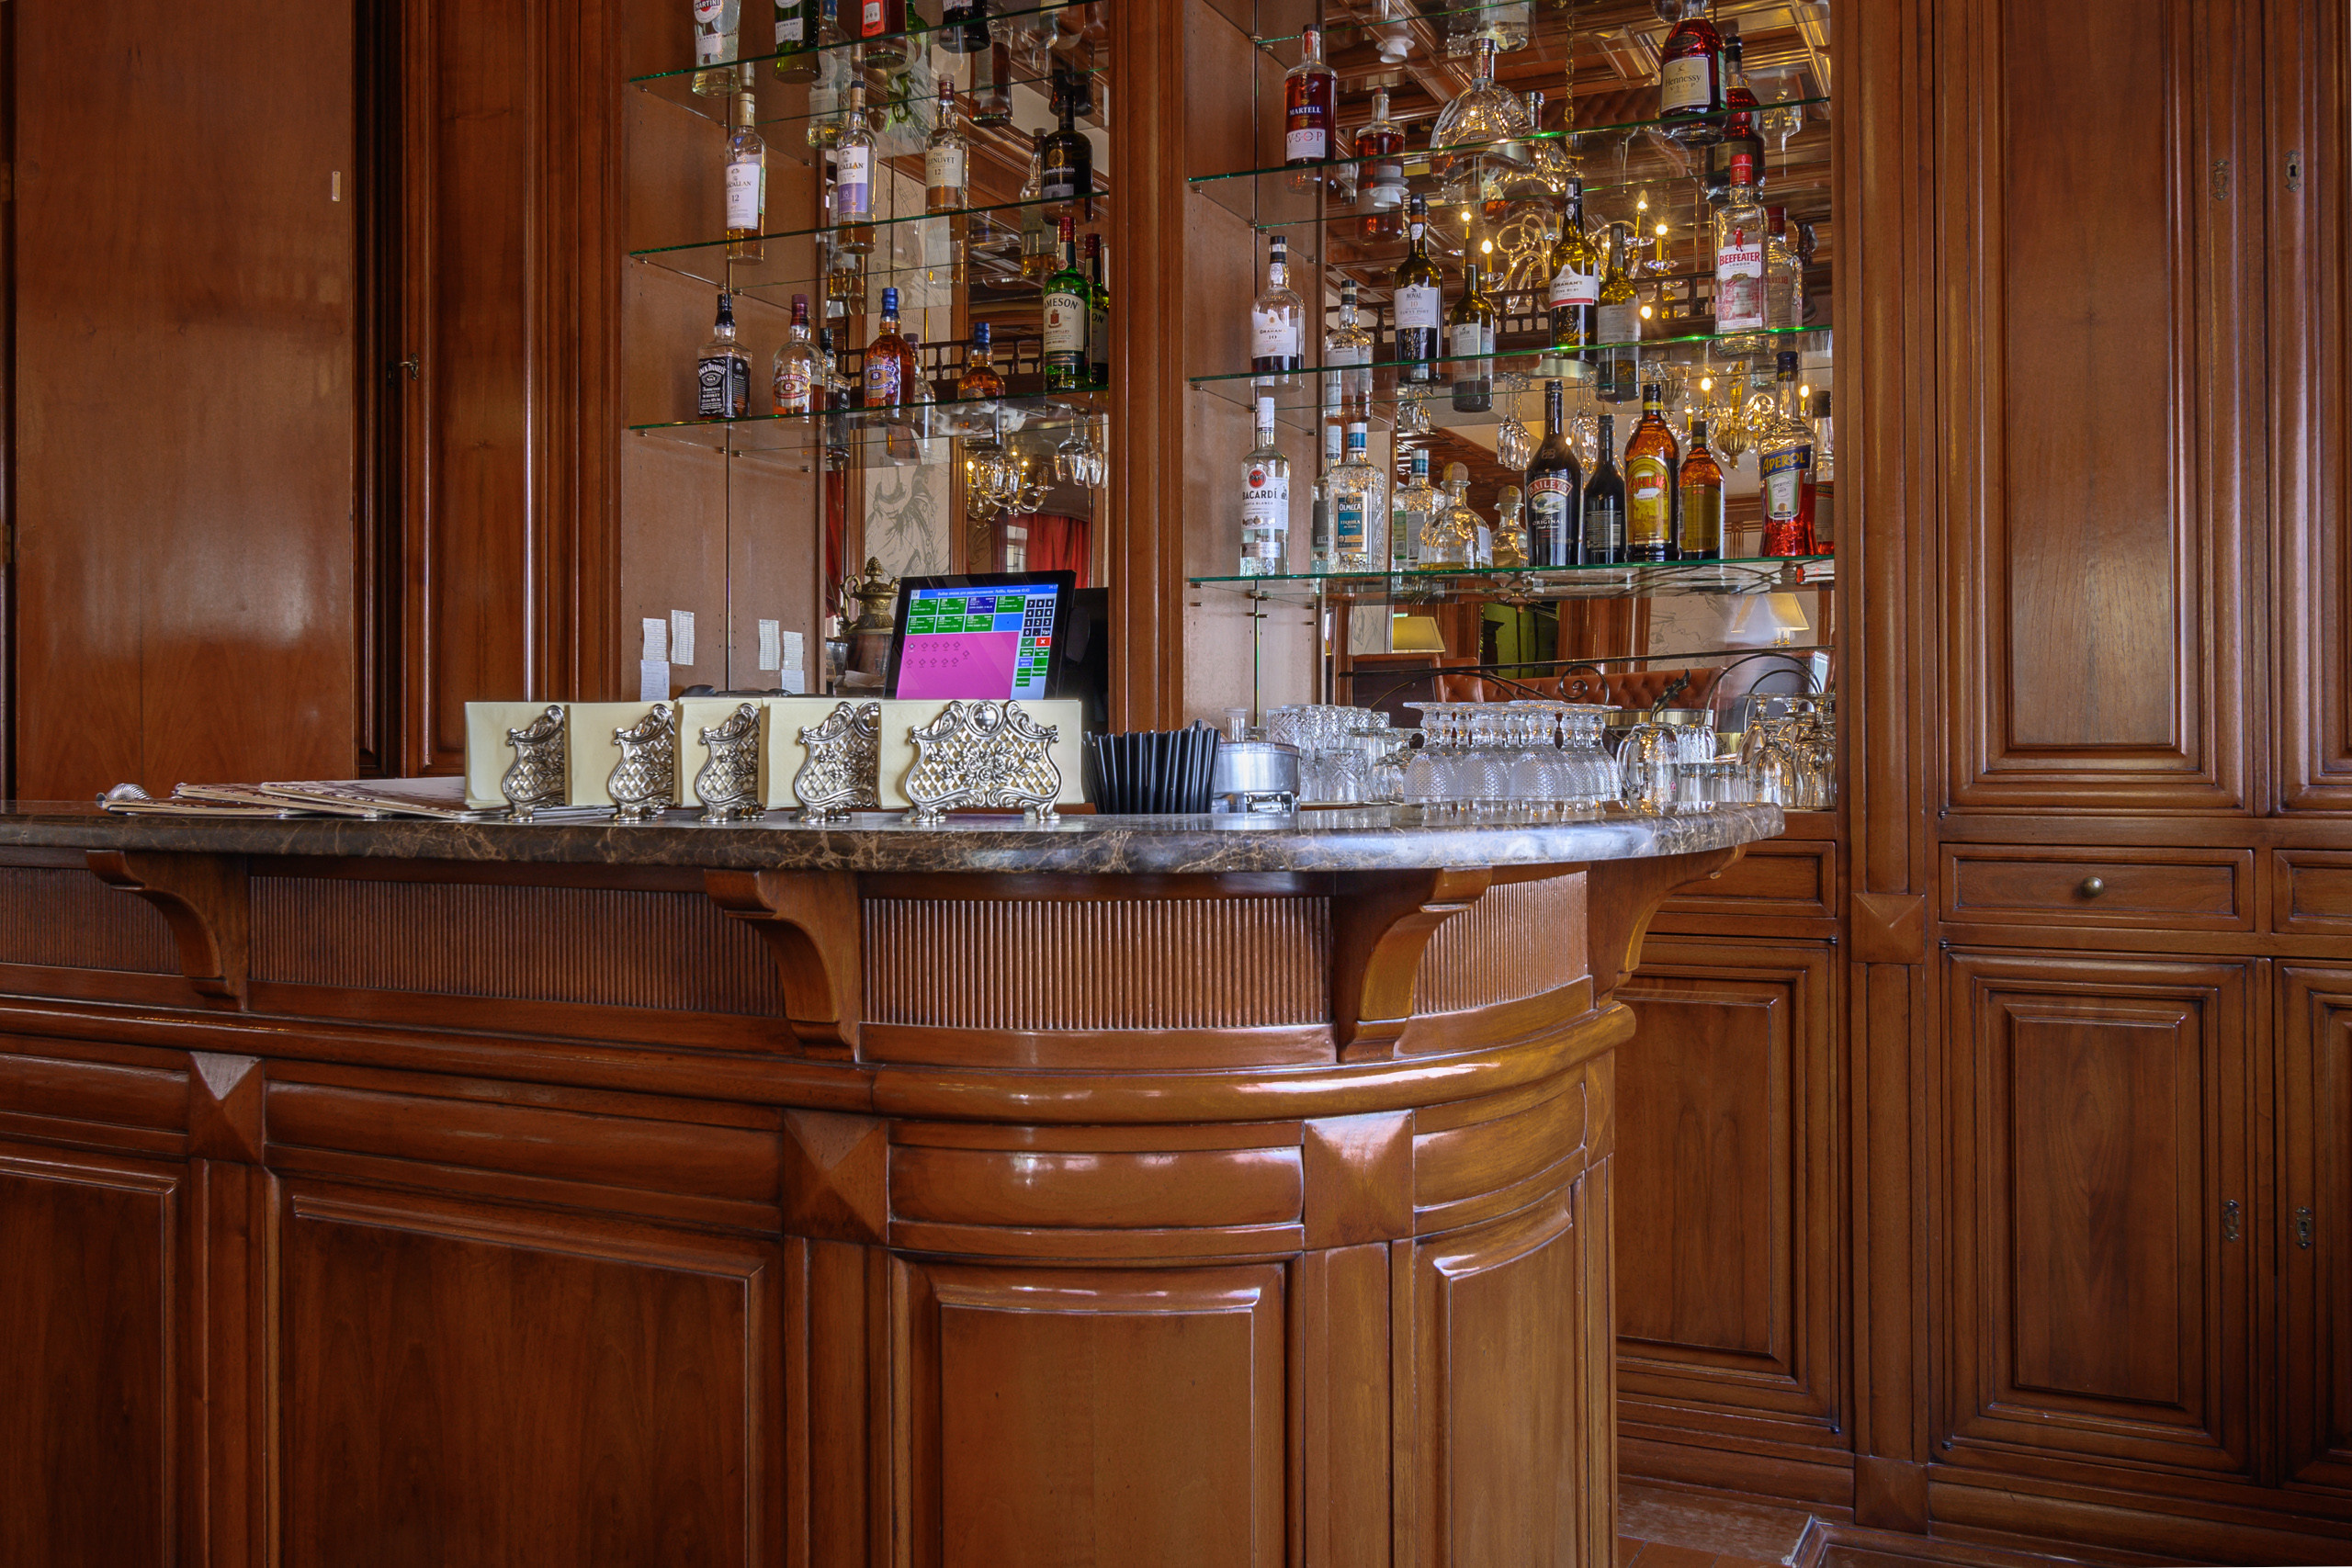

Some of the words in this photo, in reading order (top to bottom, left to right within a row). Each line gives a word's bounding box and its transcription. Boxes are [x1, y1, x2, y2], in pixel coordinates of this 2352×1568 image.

[1666, 74, 1702, 87] Hennessy
[1289, 106, 1321, 115] MARTELL
[731, 194, 740, 202] 12
[1719, 252, 1760, 266] BEEFEATER
[1762, 452, 1806, 475] APEROL
[1529, 479, 1567, 494] BAILEYS
[1242, 488, 1277, 500] BACARDÍ
